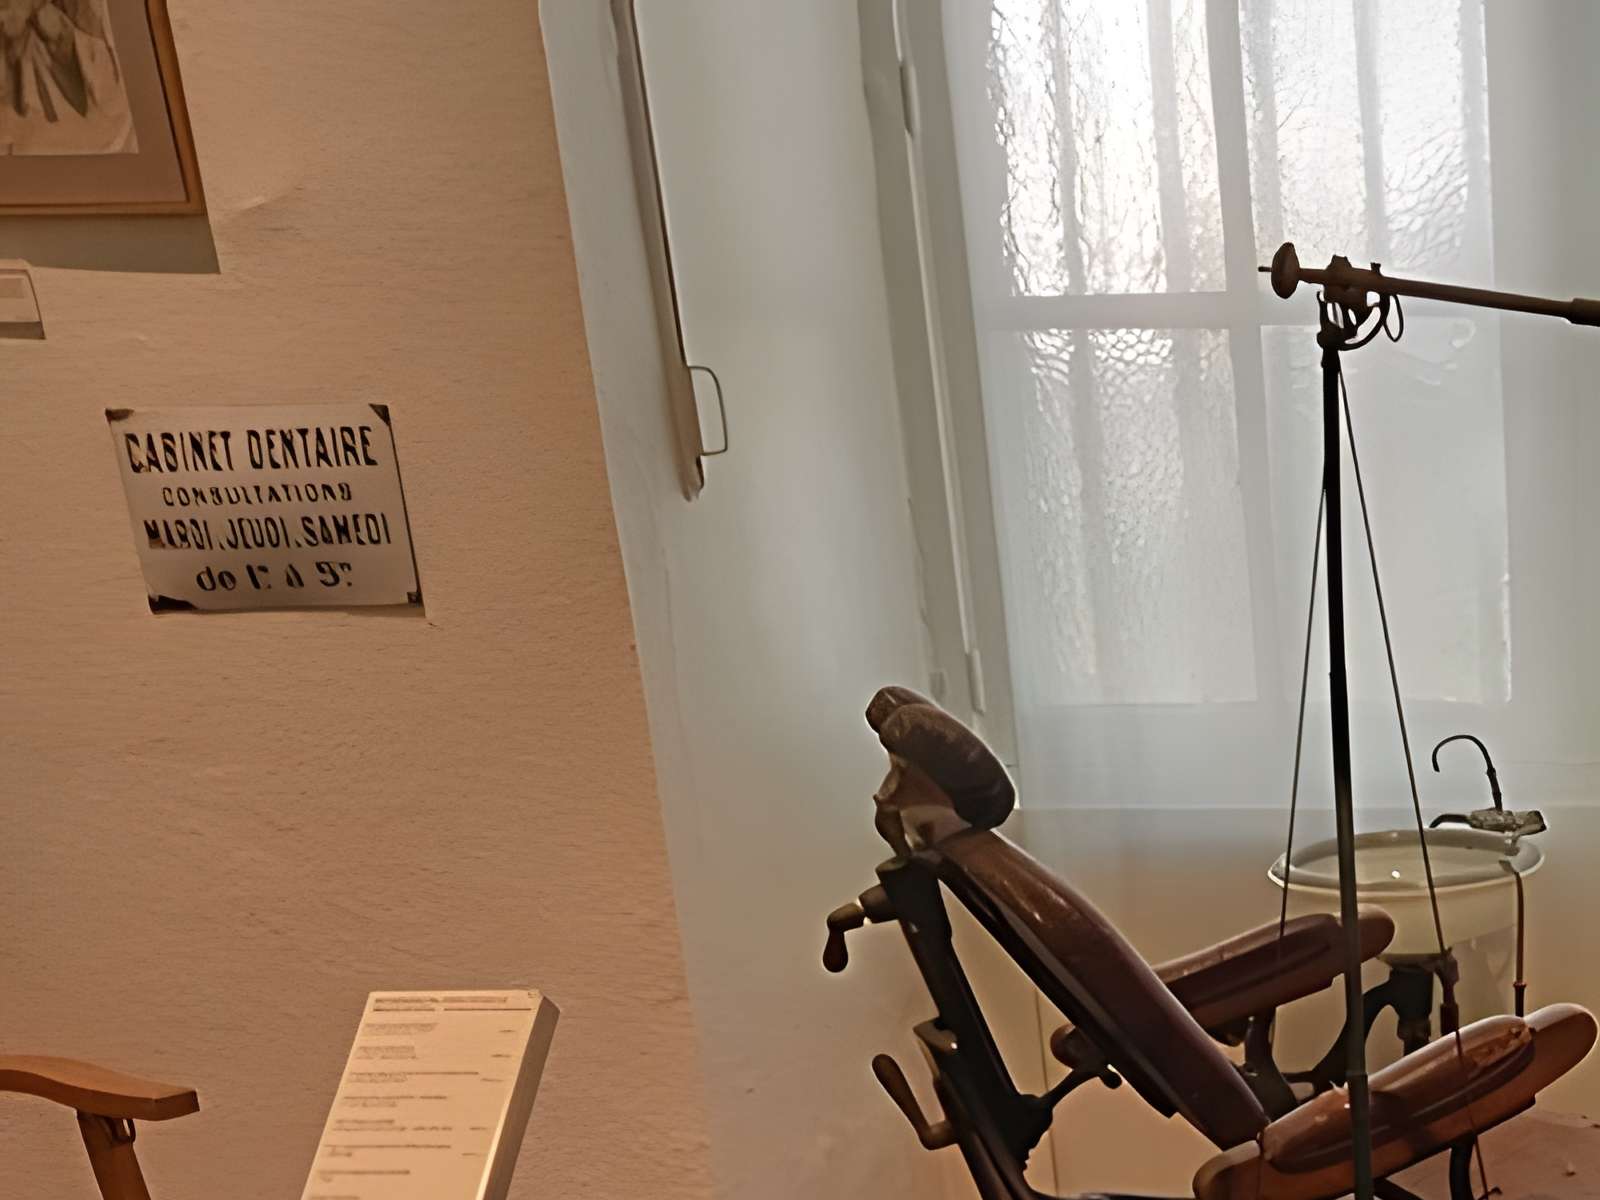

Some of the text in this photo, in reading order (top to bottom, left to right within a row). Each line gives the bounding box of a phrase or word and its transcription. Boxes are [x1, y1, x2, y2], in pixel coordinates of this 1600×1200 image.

[125, 425, 379, 474] CABINET DENTAIRE
[162, 482, 353, 506] CONSULTATIONS
[301, 512, 392, 547] SAMEDI
